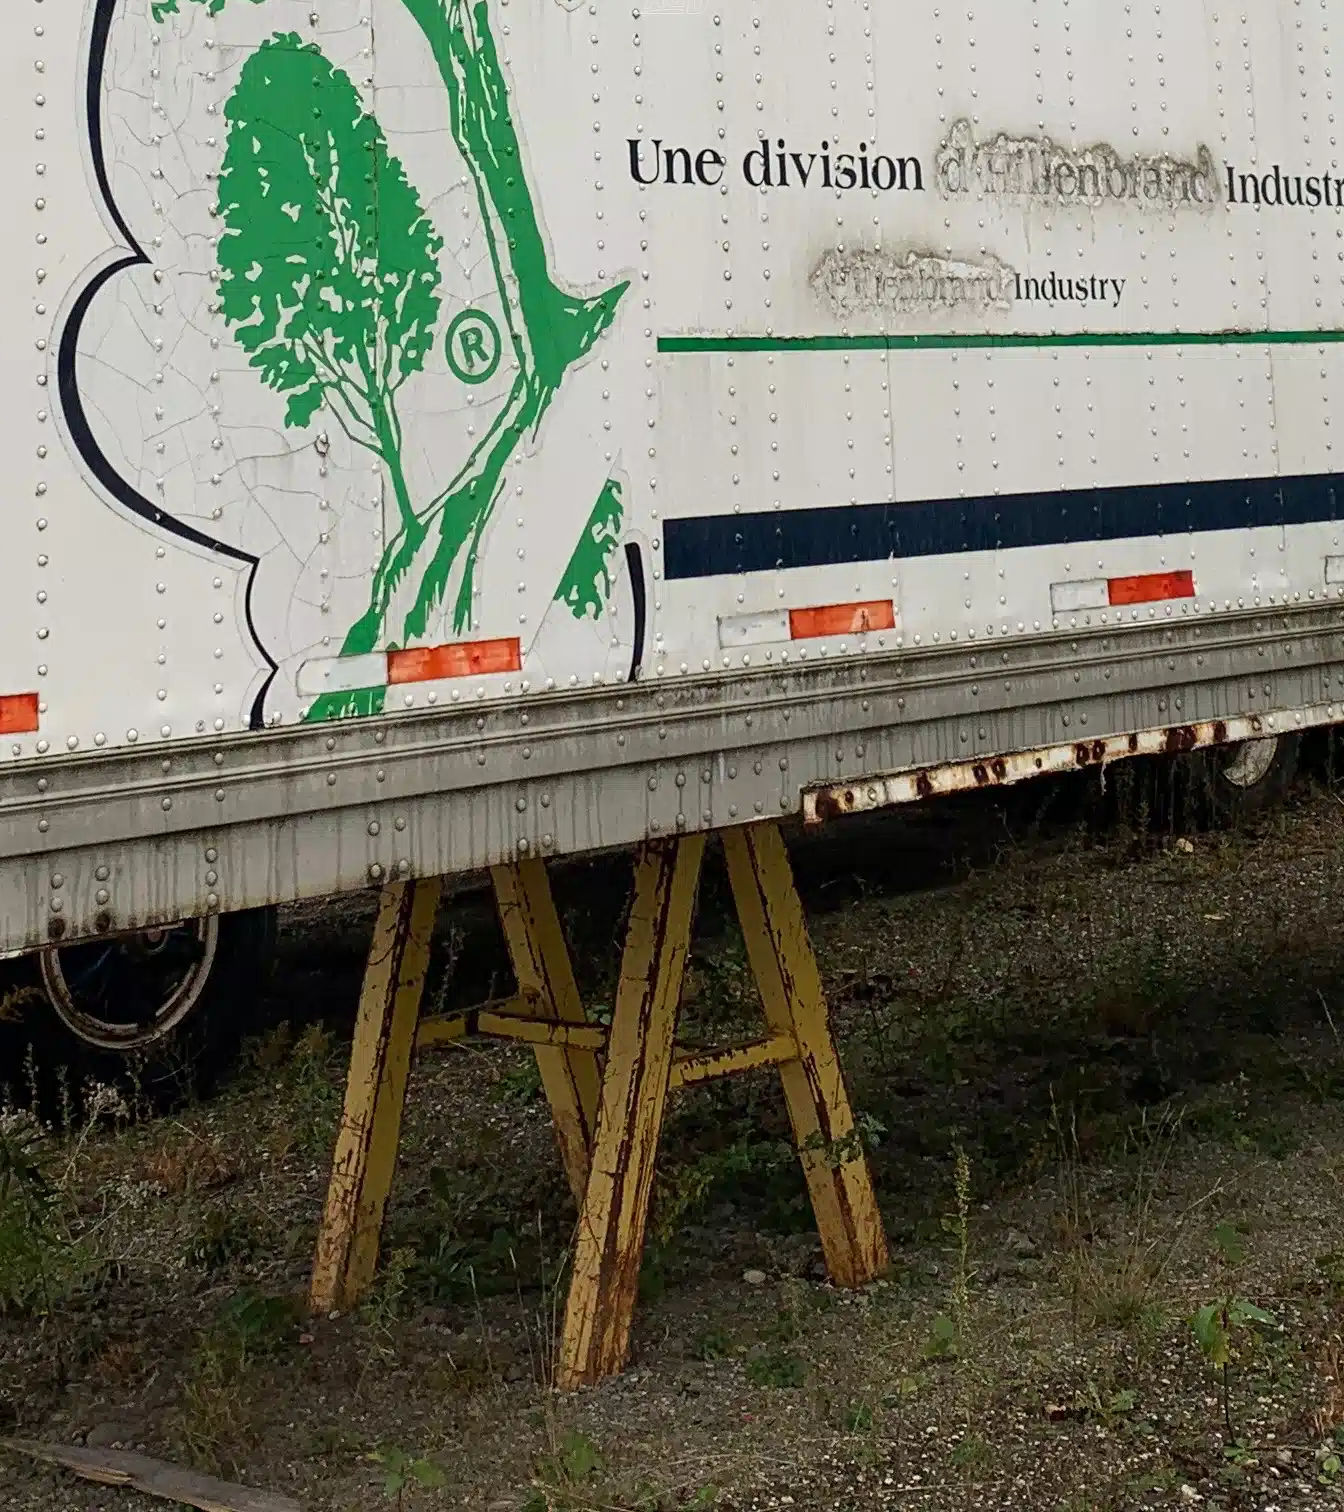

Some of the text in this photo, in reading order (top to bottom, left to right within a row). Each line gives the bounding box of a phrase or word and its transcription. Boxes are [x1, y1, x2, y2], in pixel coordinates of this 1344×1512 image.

[626, 139, 724, 185] Une
[743, 139, 926, 192] division
[1015, 271, 1126, 307] Industry
